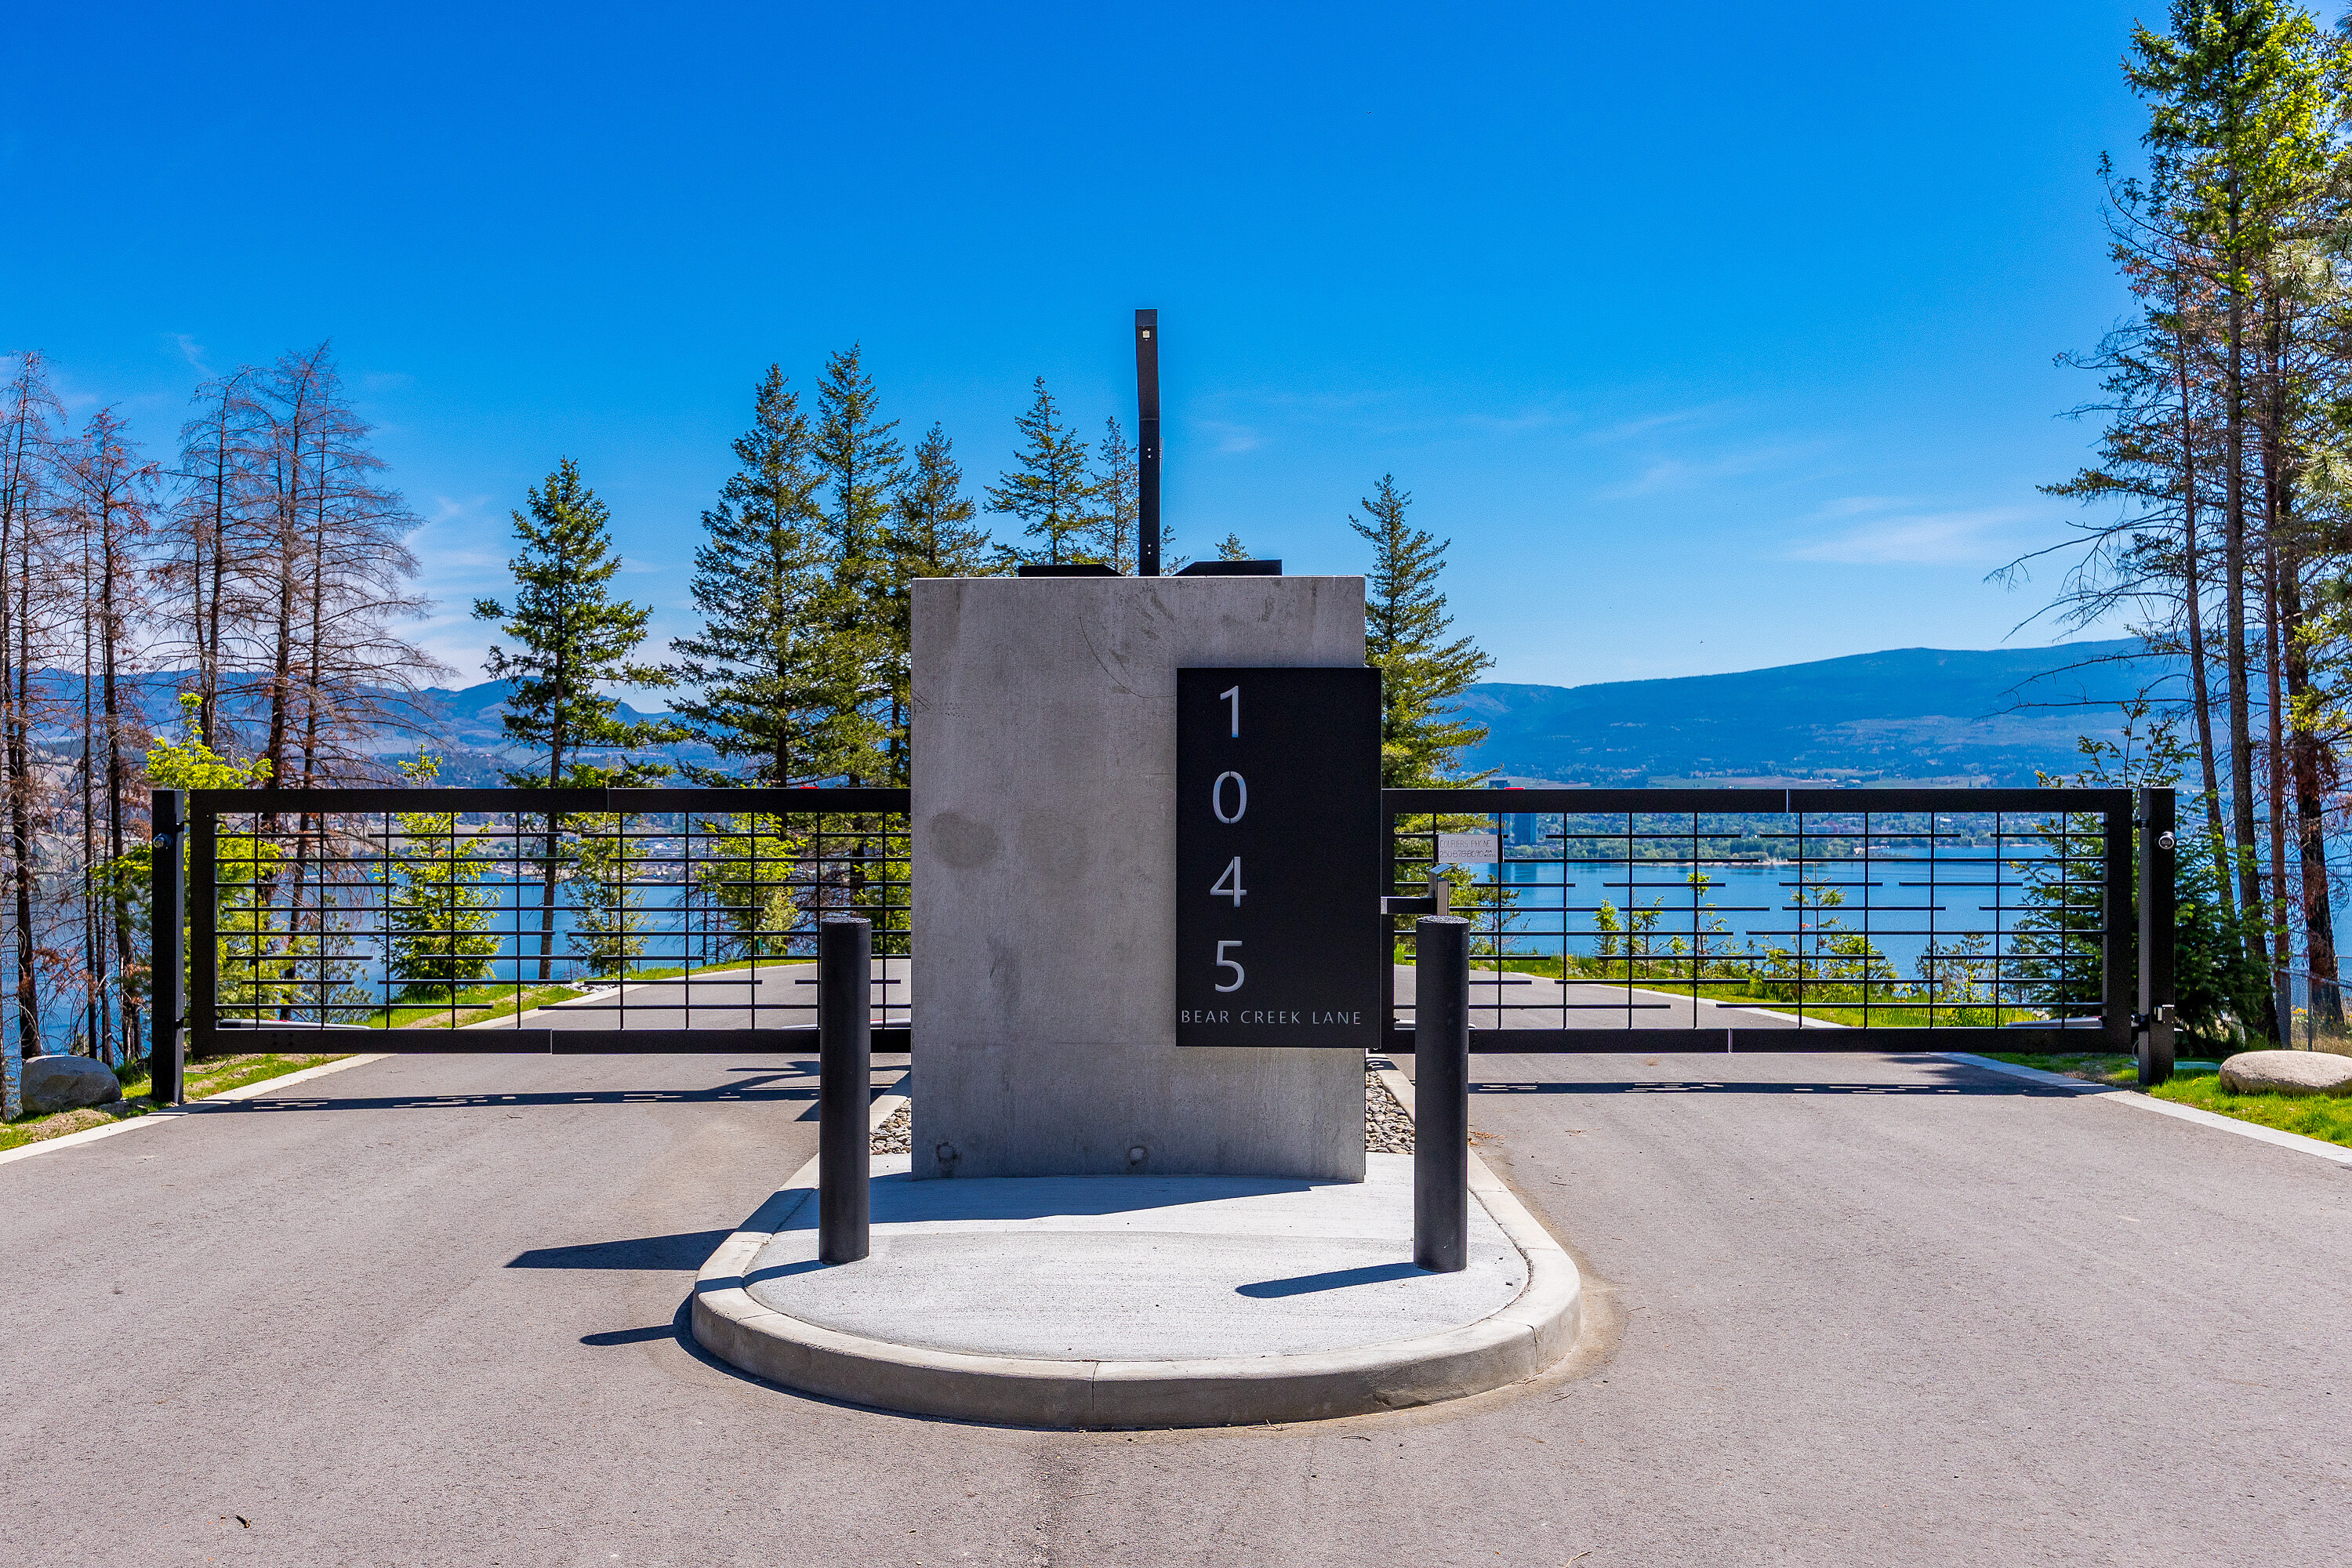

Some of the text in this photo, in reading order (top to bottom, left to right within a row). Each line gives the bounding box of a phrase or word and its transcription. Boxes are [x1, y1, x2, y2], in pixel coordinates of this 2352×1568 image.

[1210, 685, 1247, 993] 1045
[1439, 840, 1468, 848] COURIERS
[1181, 1010, 1361, 1025] BEAR CREEK LANE
